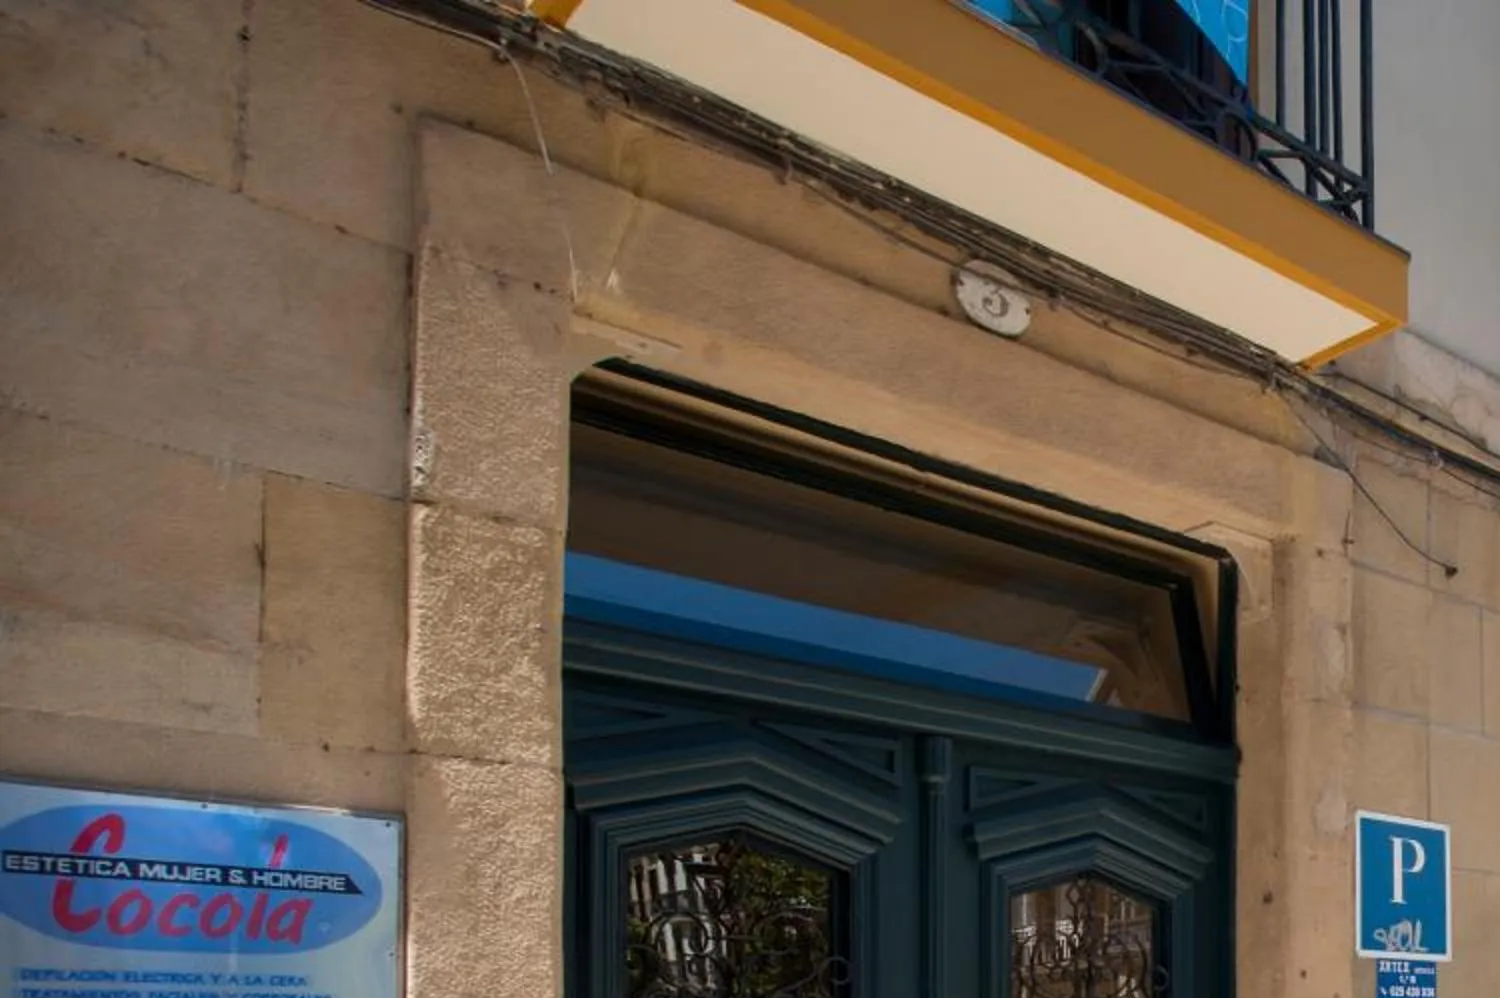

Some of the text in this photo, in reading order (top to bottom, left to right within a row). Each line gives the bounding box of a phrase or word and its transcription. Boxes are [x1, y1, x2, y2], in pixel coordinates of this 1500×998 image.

[982, 281, 1009, 317] 3
[5, 854, 347, 891] ESTETICA MUJER & HOMBRE
[1389, 836, 1426, 904] P
[229, 975, 239, 985] A
